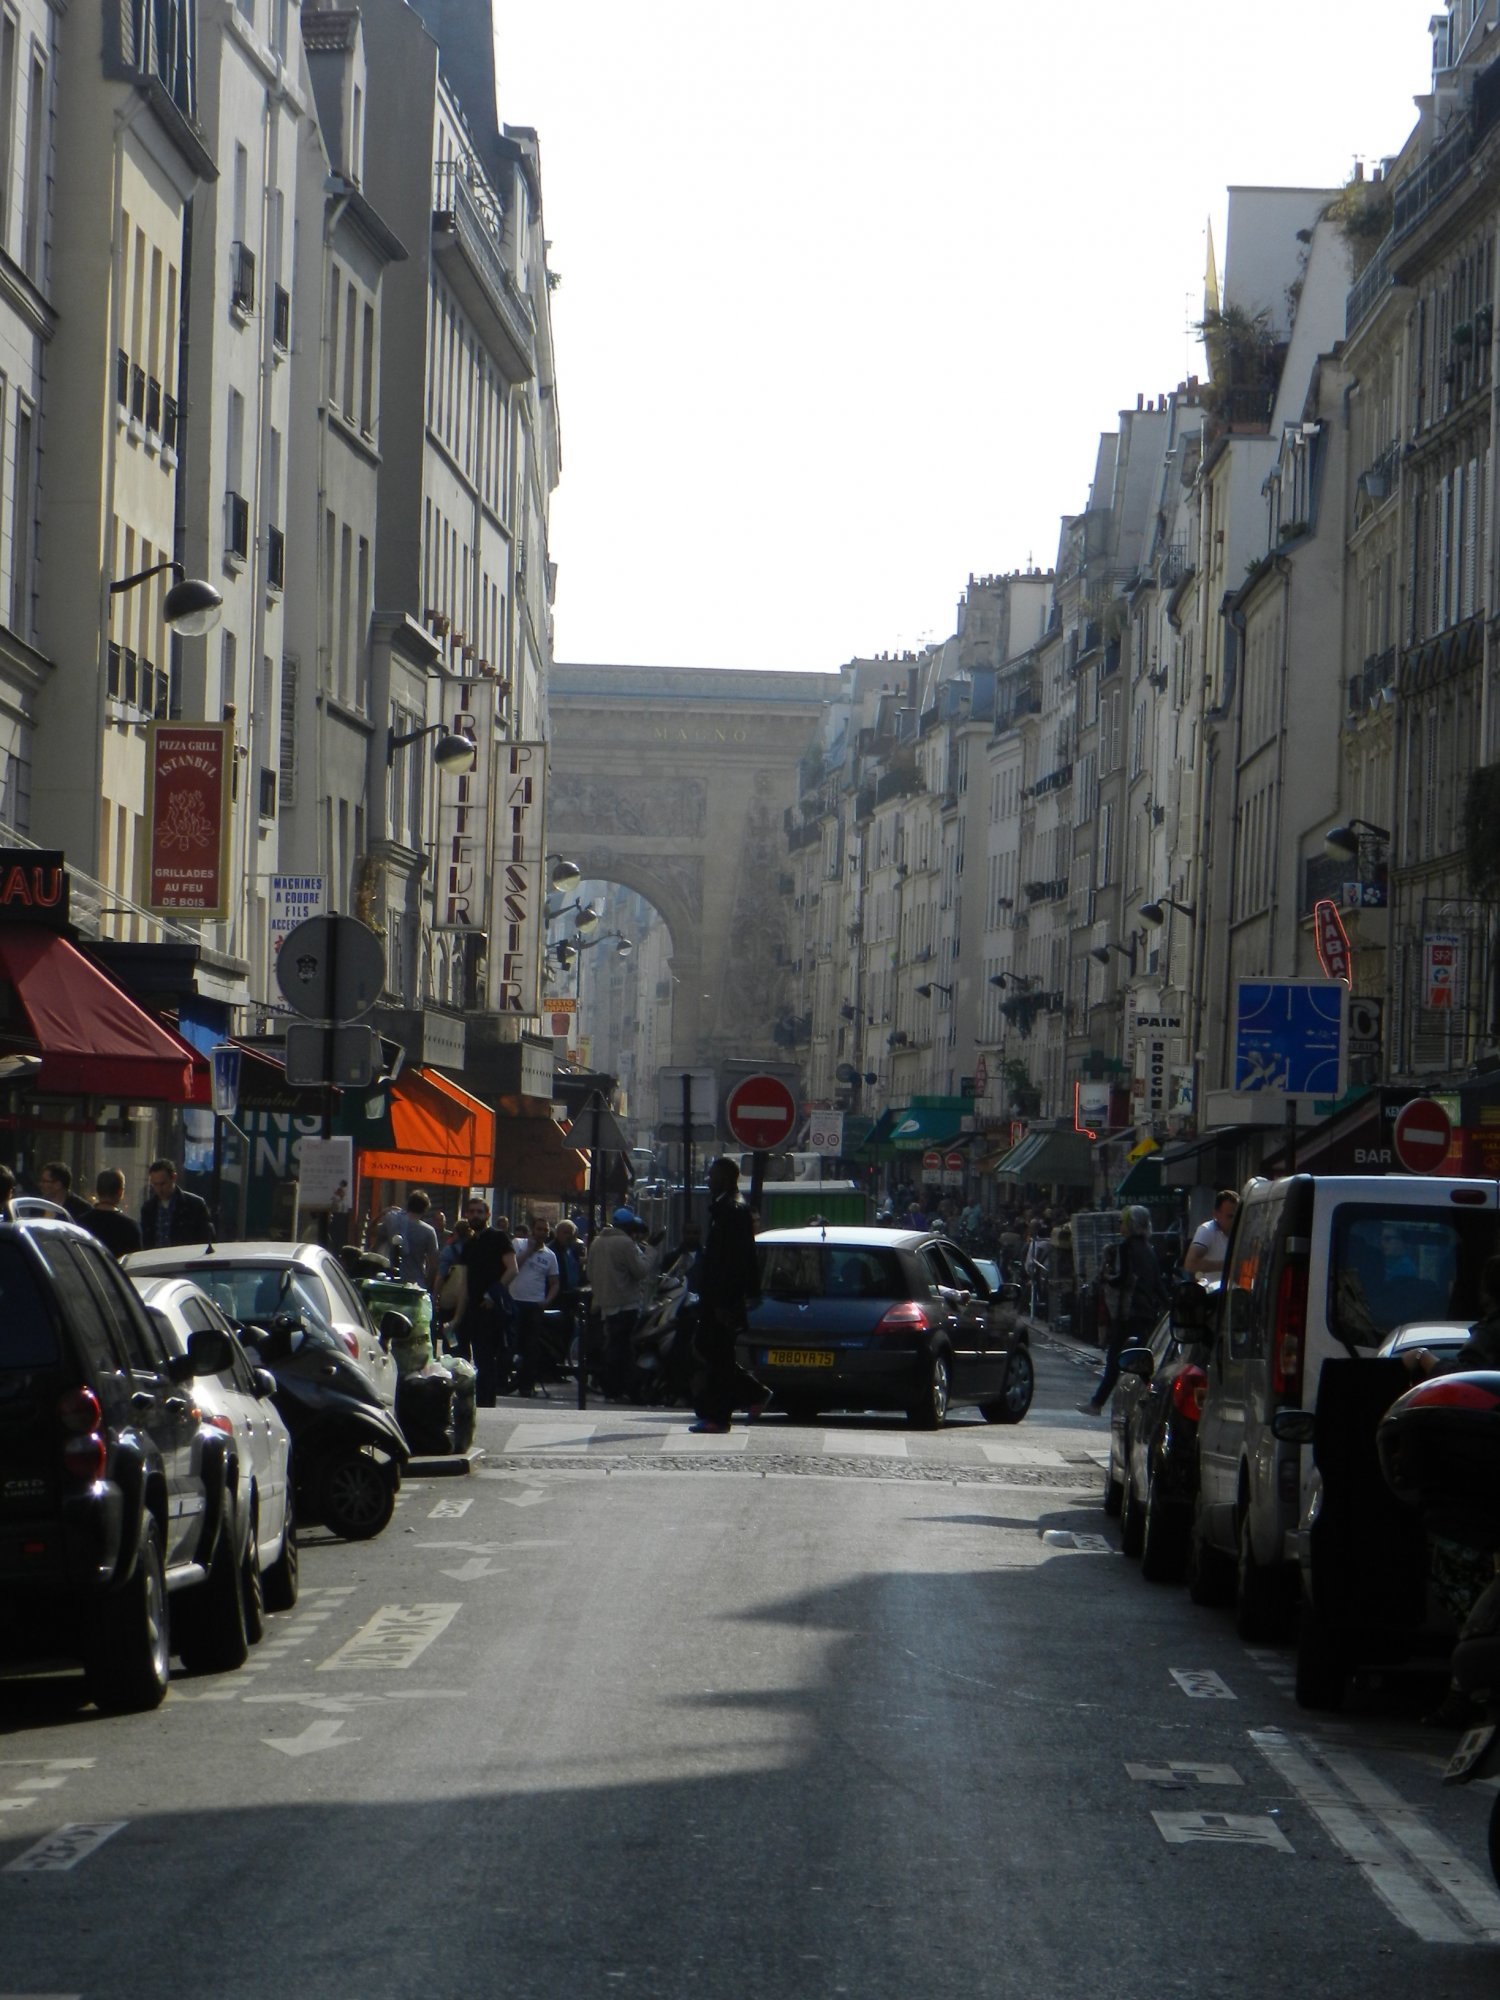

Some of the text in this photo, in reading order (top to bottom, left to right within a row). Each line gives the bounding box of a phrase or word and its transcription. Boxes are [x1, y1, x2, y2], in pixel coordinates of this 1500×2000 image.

[654, 727, 747, 743] MAGNO
[158, 740, 217, 752] PIZZA GRILL
[158, 754, 217, 779] ISTANBUL
[155, 868, 215, 879] GRILLADES
[499, 746, 533, 1011] PATISSIER
[0, 864, 64, 907] AU
[164, 883, 203, 893] AU FEU
[273, 877, 322, 890] MACHINES
[162, 897, 205, 907] DE BOIS
[285, 892, 320, 904] COUDRE
[285, 905, 309, 917] FILS
[1433, 950, 1451, 961] SFR
[1137, 1017, 1181, 1028] PAIN
[1151, 1042, 1165, 1109] BROCHE
[1354, 1148, 1392, 1164] BAR
[371, 1160, 424, 1175] SANDWICH
